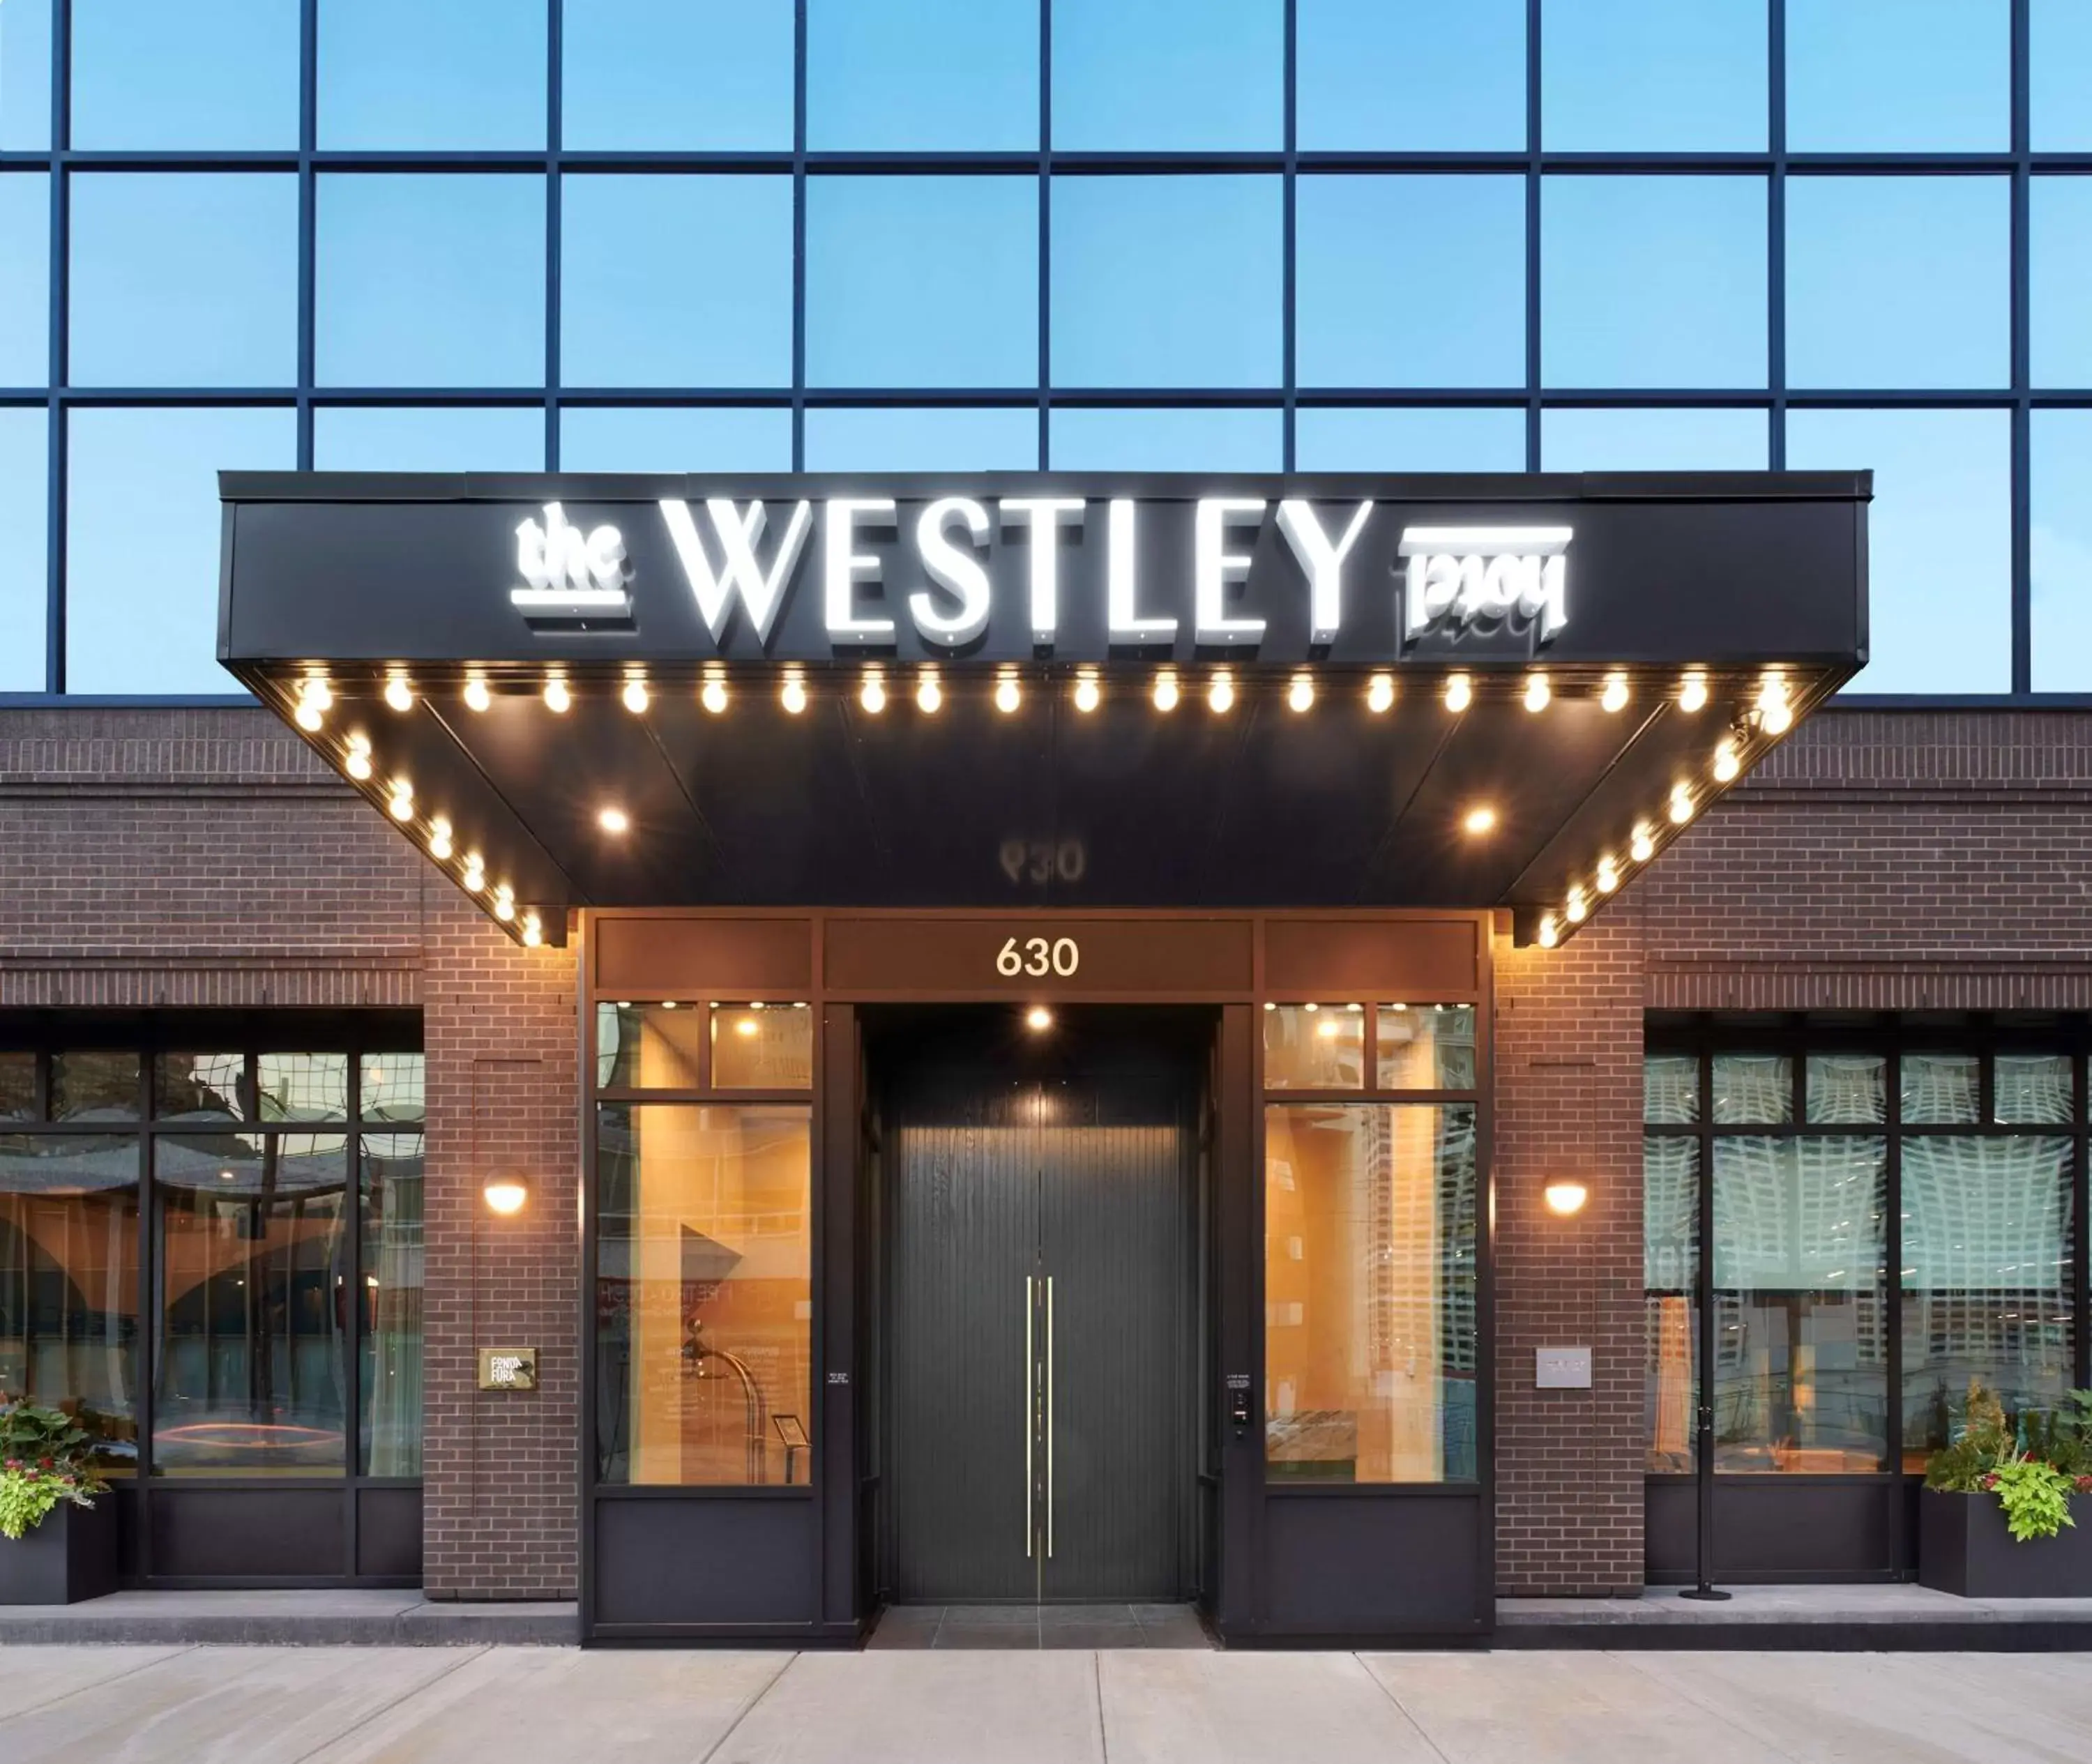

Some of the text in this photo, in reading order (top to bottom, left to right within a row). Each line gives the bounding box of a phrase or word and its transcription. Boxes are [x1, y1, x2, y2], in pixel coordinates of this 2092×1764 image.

[515, 501, 626, 590] the
[659, 498, 1374, 645] WESTLEY
[996, 937, 1079, 976] 630
